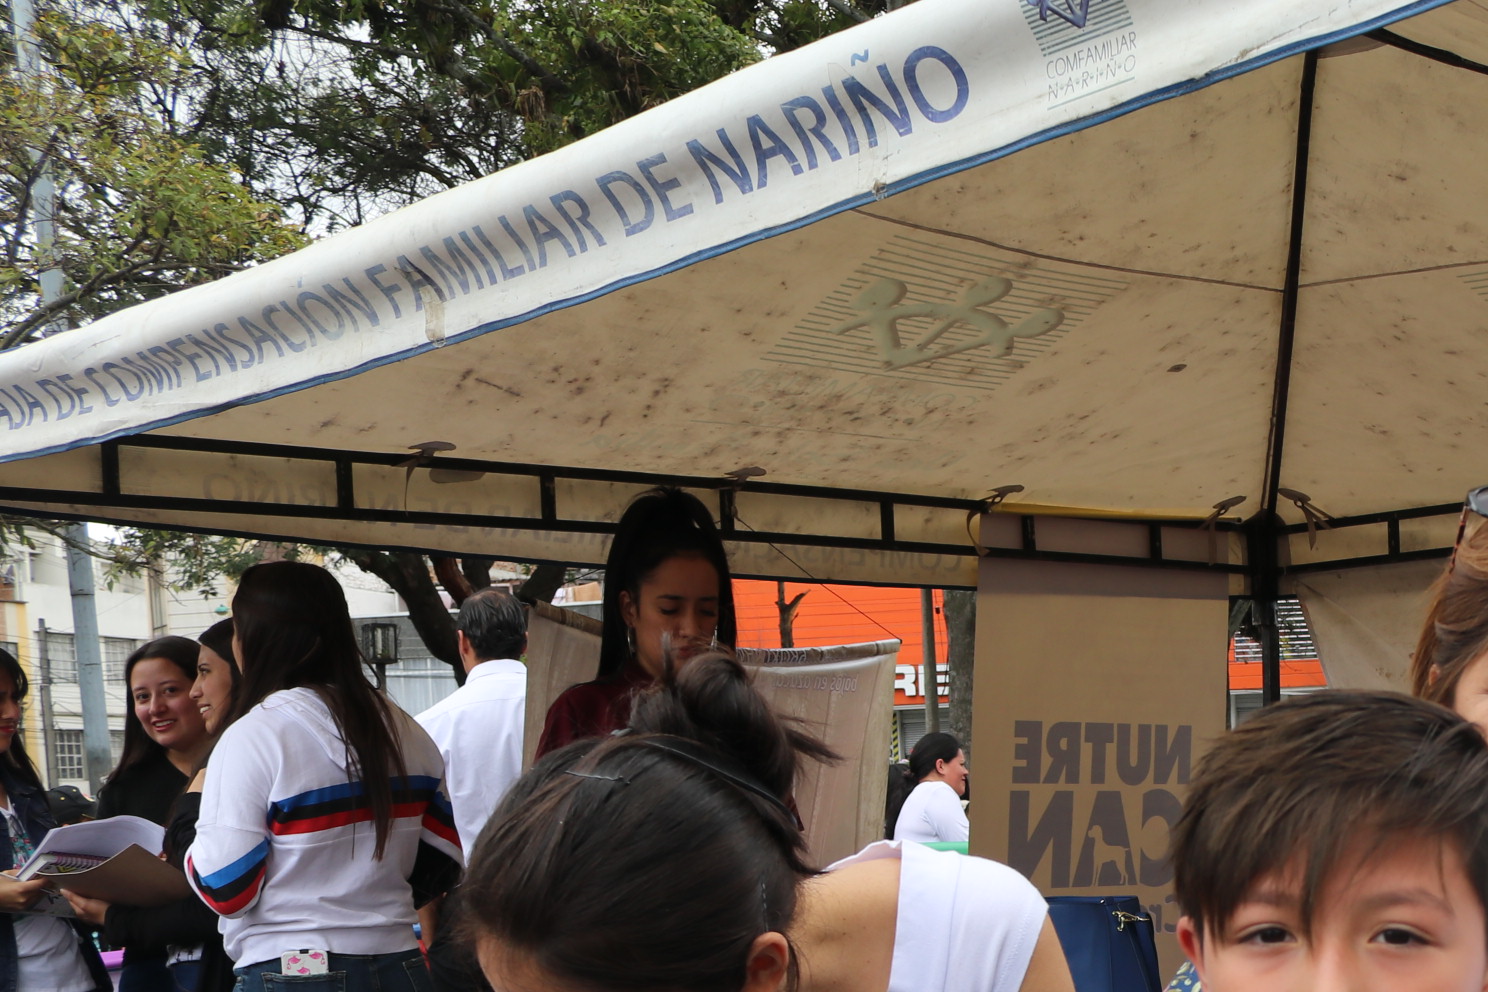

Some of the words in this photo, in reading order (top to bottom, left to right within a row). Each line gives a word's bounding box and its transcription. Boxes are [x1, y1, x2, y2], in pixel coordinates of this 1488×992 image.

[1045, 31, 1137, 79] COMFAMILIAR
[43, 373, 94, 421] DE
[84, 279, 380, 407] COMPENSACIÓN
[364, 189, 608, 319] FAMILIAR
[595, 152, 695, 238] DE
[686, 45, 970, 205] NARIÑO
